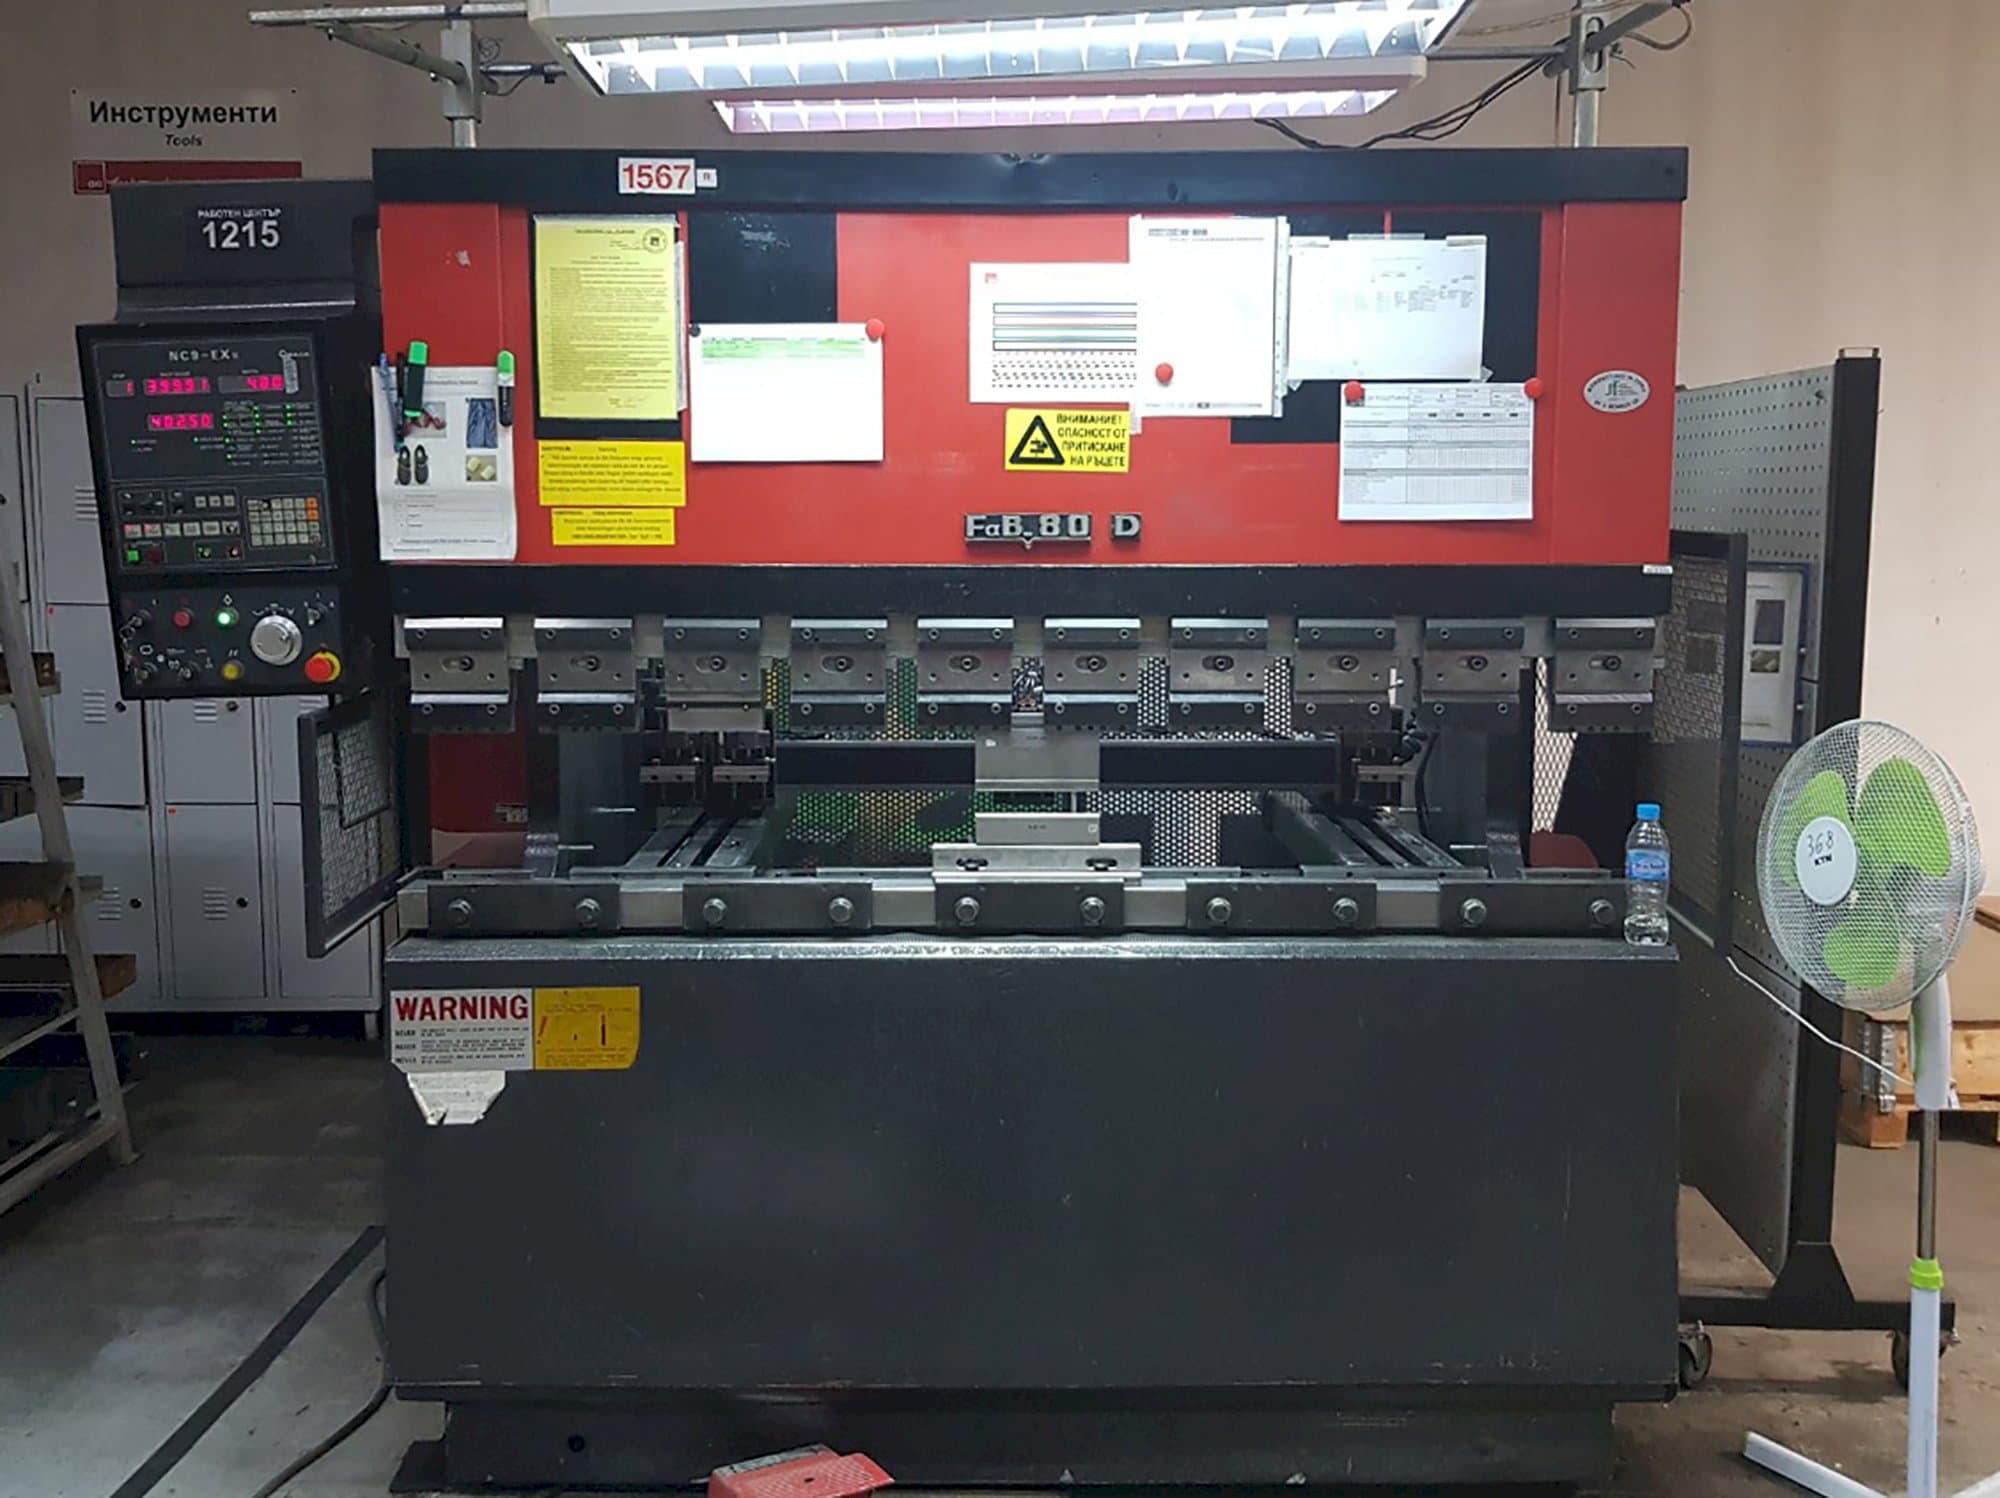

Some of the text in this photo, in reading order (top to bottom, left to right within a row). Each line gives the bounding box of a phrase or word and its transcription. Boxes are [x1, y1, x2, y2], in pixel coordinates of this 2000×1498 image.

[90, 101, 277, 129] Инструменти
[164, 133, 203, 147] Tools
[622, 163, 691, 190] 1567
[197, 209, 241, 218] РАБОТЕН
[202, 220, 280, 249] 1215
[1056, 413, 1122, 425] ВНИМАНИЕ!
[1112, 428, 1127, 439] ОТ
[1114, 514, 1141, 536] D
[1807, 829, 1834, 857] 368
[395, 996, 528, 1021] WARNING
